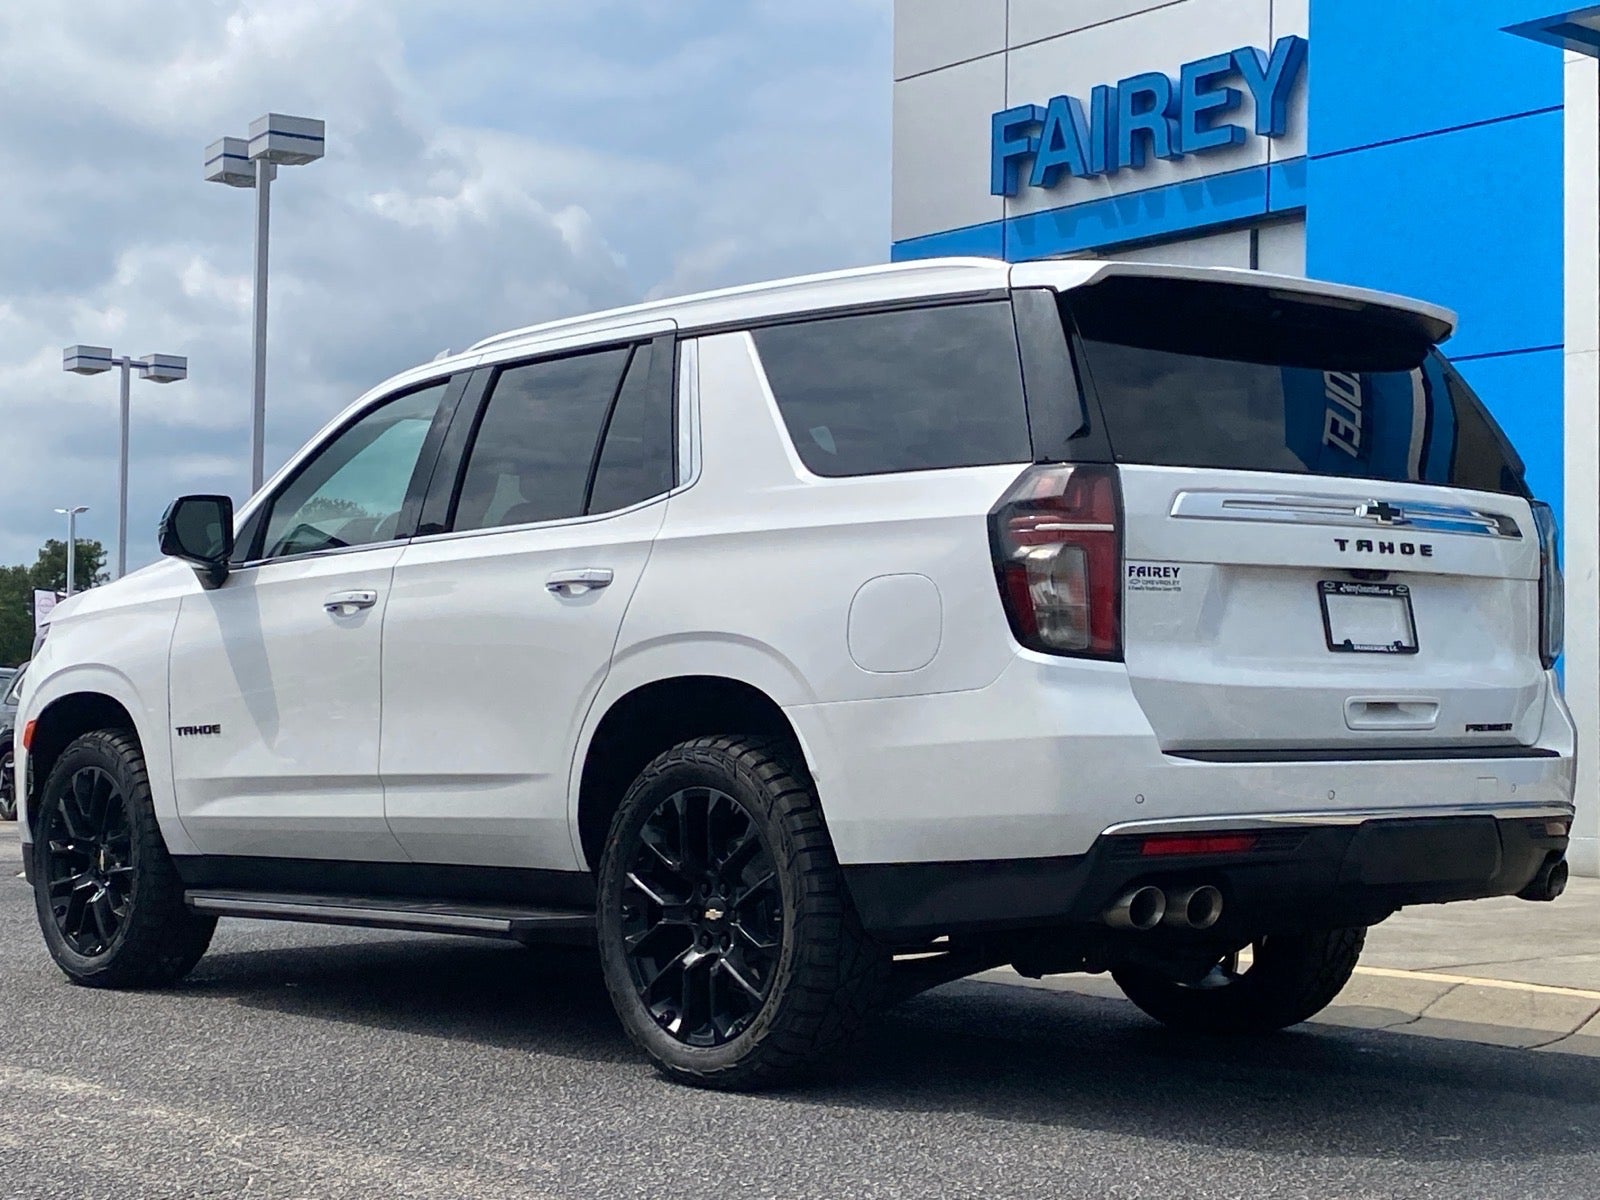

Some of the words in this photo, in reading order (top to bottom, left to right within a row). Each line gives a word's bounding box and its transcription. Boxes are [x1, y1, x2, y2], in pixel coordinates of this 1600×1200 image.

[991, 35, 1308, 197] FAIREY
[1334, 538, 1433, 557] TAHOE
[1128, 566, 1180, 578] FAIREY
[175, 723, 221, 736] TAHOE
